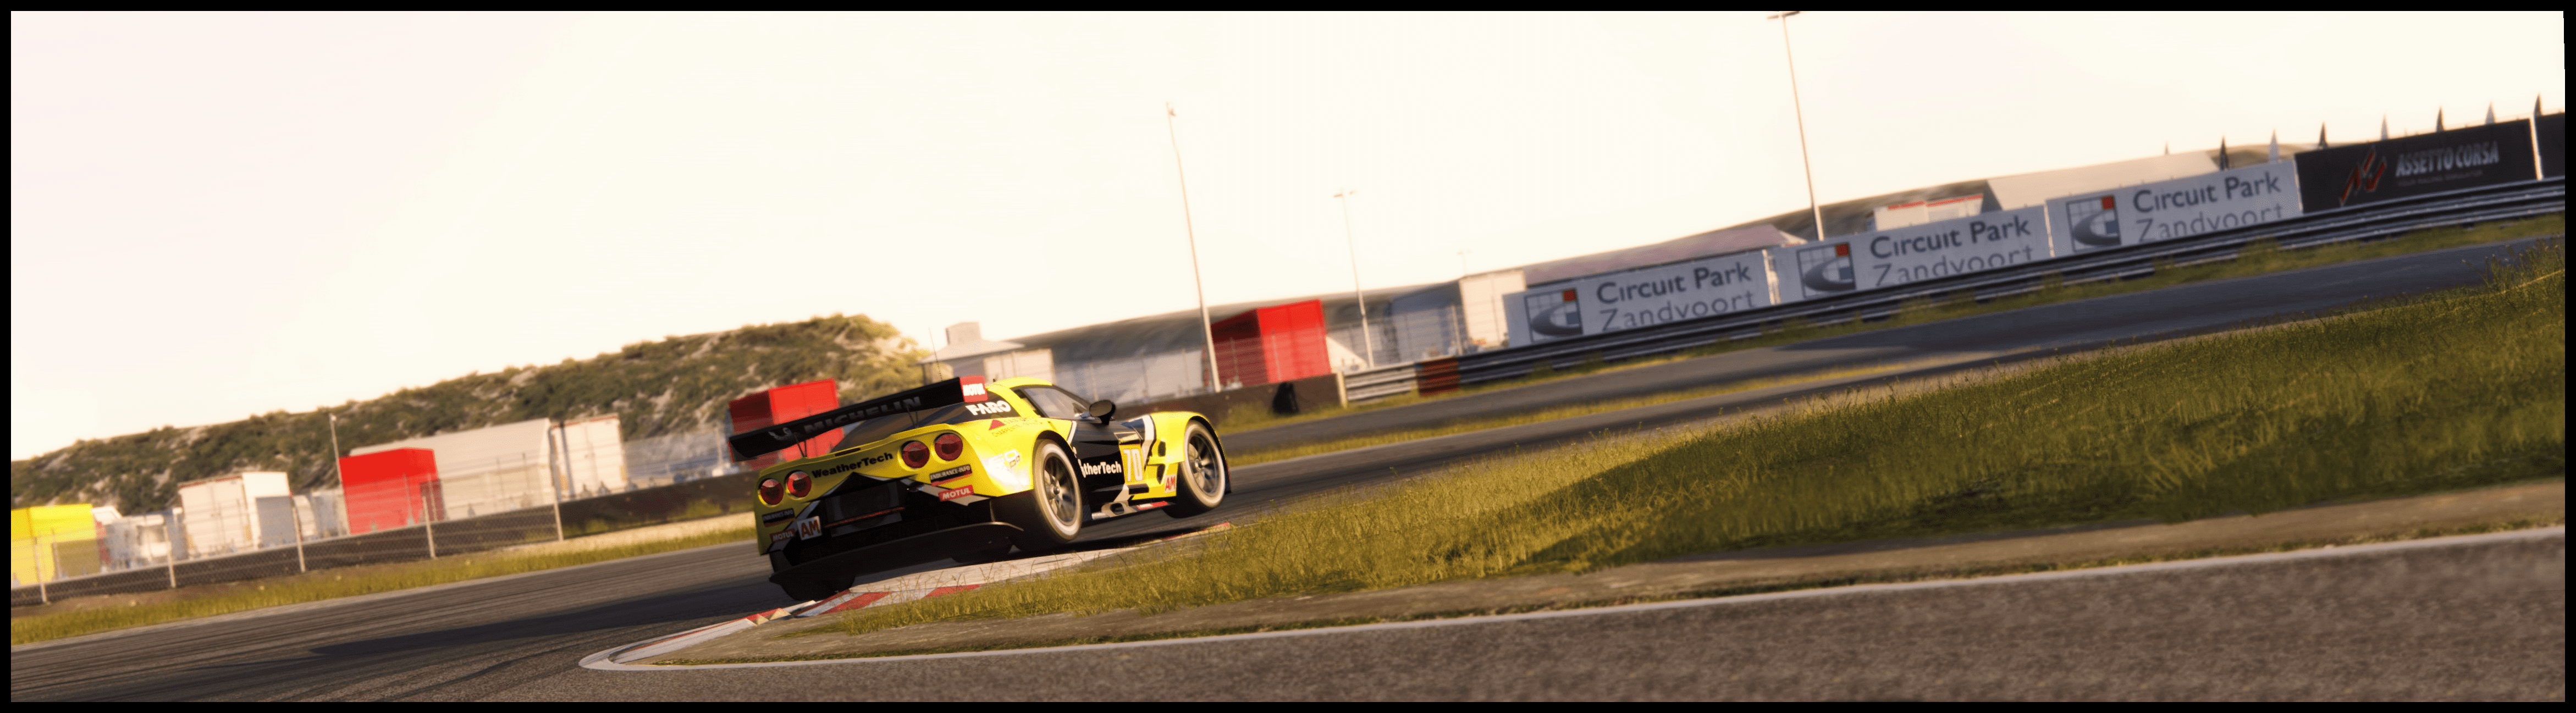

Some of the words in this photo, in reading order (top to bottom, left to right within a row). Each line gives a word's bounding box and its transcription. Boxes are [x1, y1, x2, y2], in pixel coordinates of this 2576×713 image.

[2395, 147, 2453, 178] ASSETTO
[2456, 141, 2499, 168] CORSA
[2133, 185, 2218, 213] Circuit
[2224, 172, 2281, 200] Park
[1870, 230, 1962, 258] Circuit
[1970, 214, 2031, 244] Park
[2136, 203, 2282, 243] Zandvoort
[1597, 275, 1686, 304] Circuit
[1694, 262, 1751, 289] Park
[1872, 245, 2033, 288] Zandvoort
[1599, 290, 1757, 333] Zandvoort
[962, 383, 986, 396] MOTUL
[804, 396, 922, 433] MICHELIN
[965, 400, 1012, 416] FARO
[811, 451, 893, 478] WeatherTech
[1123, 448, 1143, 482] 70
[942, 487, 971, 500] MOTUL
[1165, 476, 1176, 491] AM
[773, 530, 795, 541] MOTUL
[801, 519, 821, 538] AM
